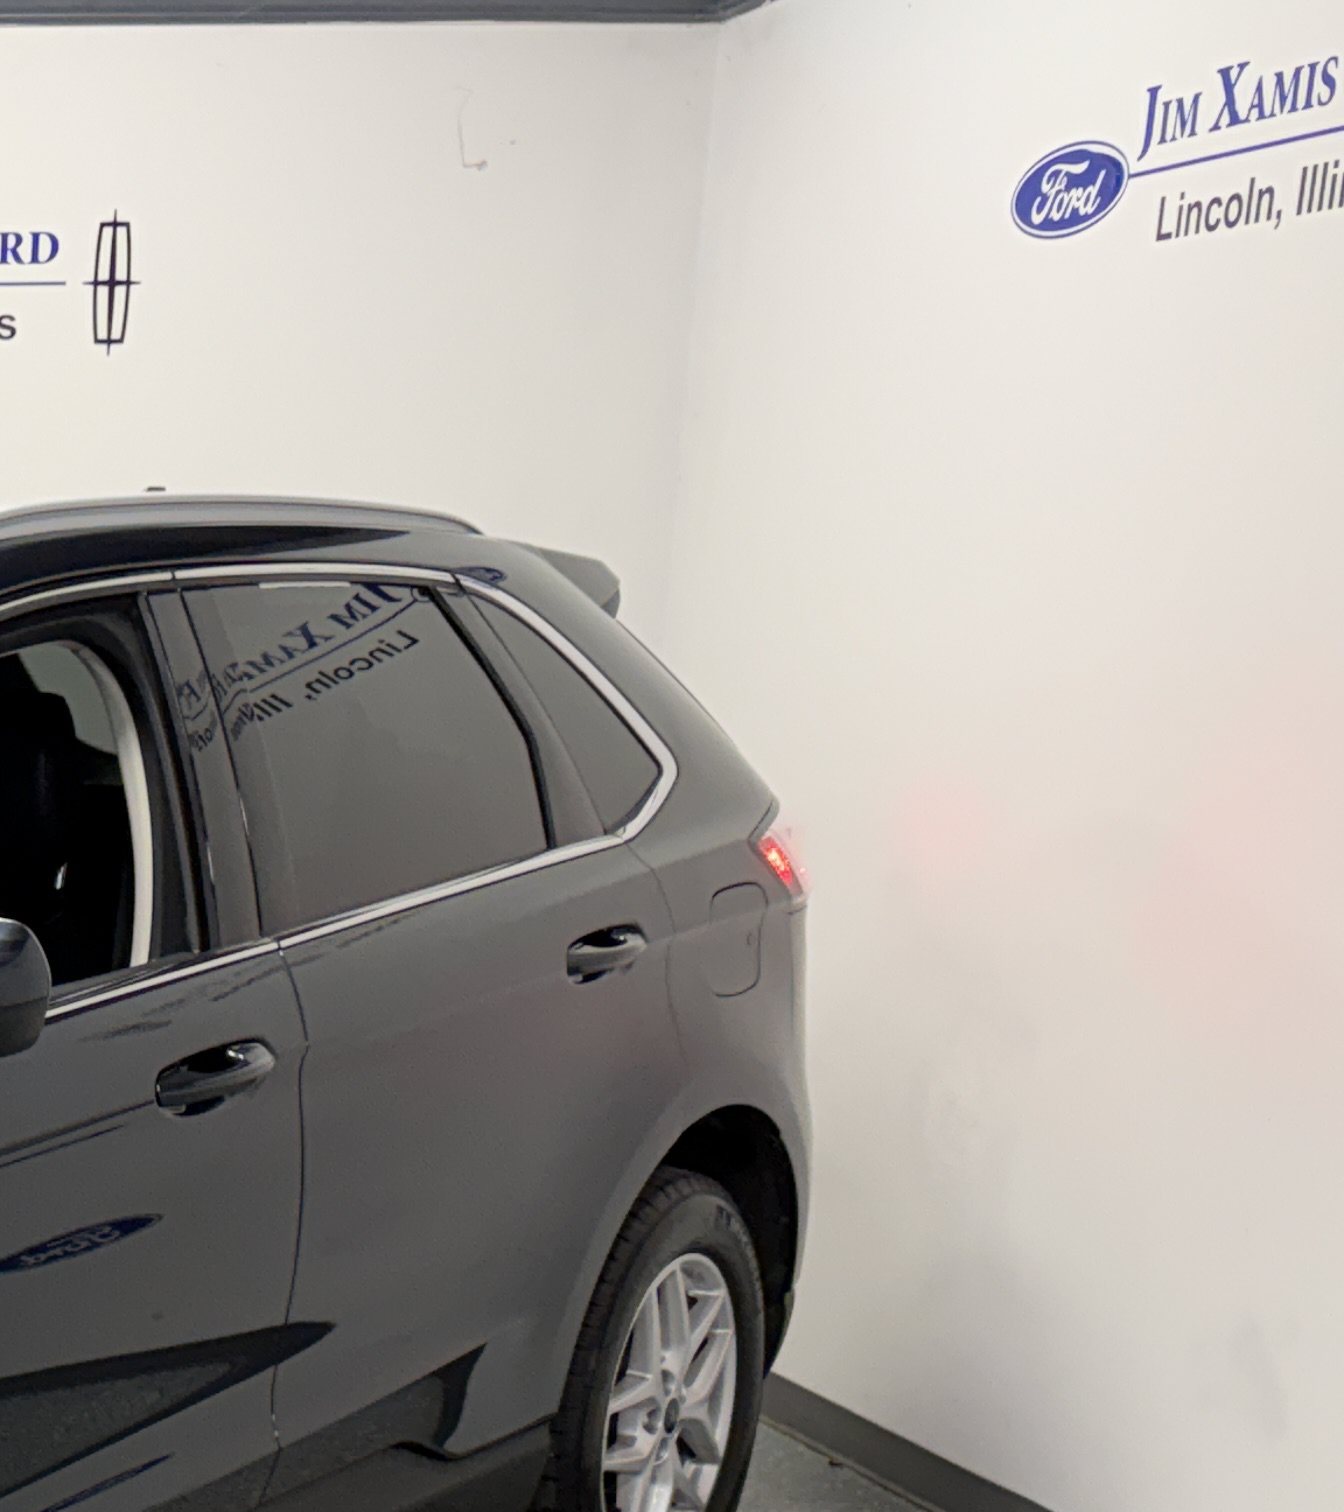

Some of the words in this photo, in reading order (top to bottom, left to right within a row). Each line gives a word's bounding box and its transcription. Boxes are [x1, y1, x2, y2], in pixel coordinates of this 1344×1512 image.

[1137, 84, 1203, 162] JIM
[1209, 55, 1339, 133] XAMIS
[1030, 159, 1108, 226] Ford
[1155, 176, 1283, 242] Lincoln,
